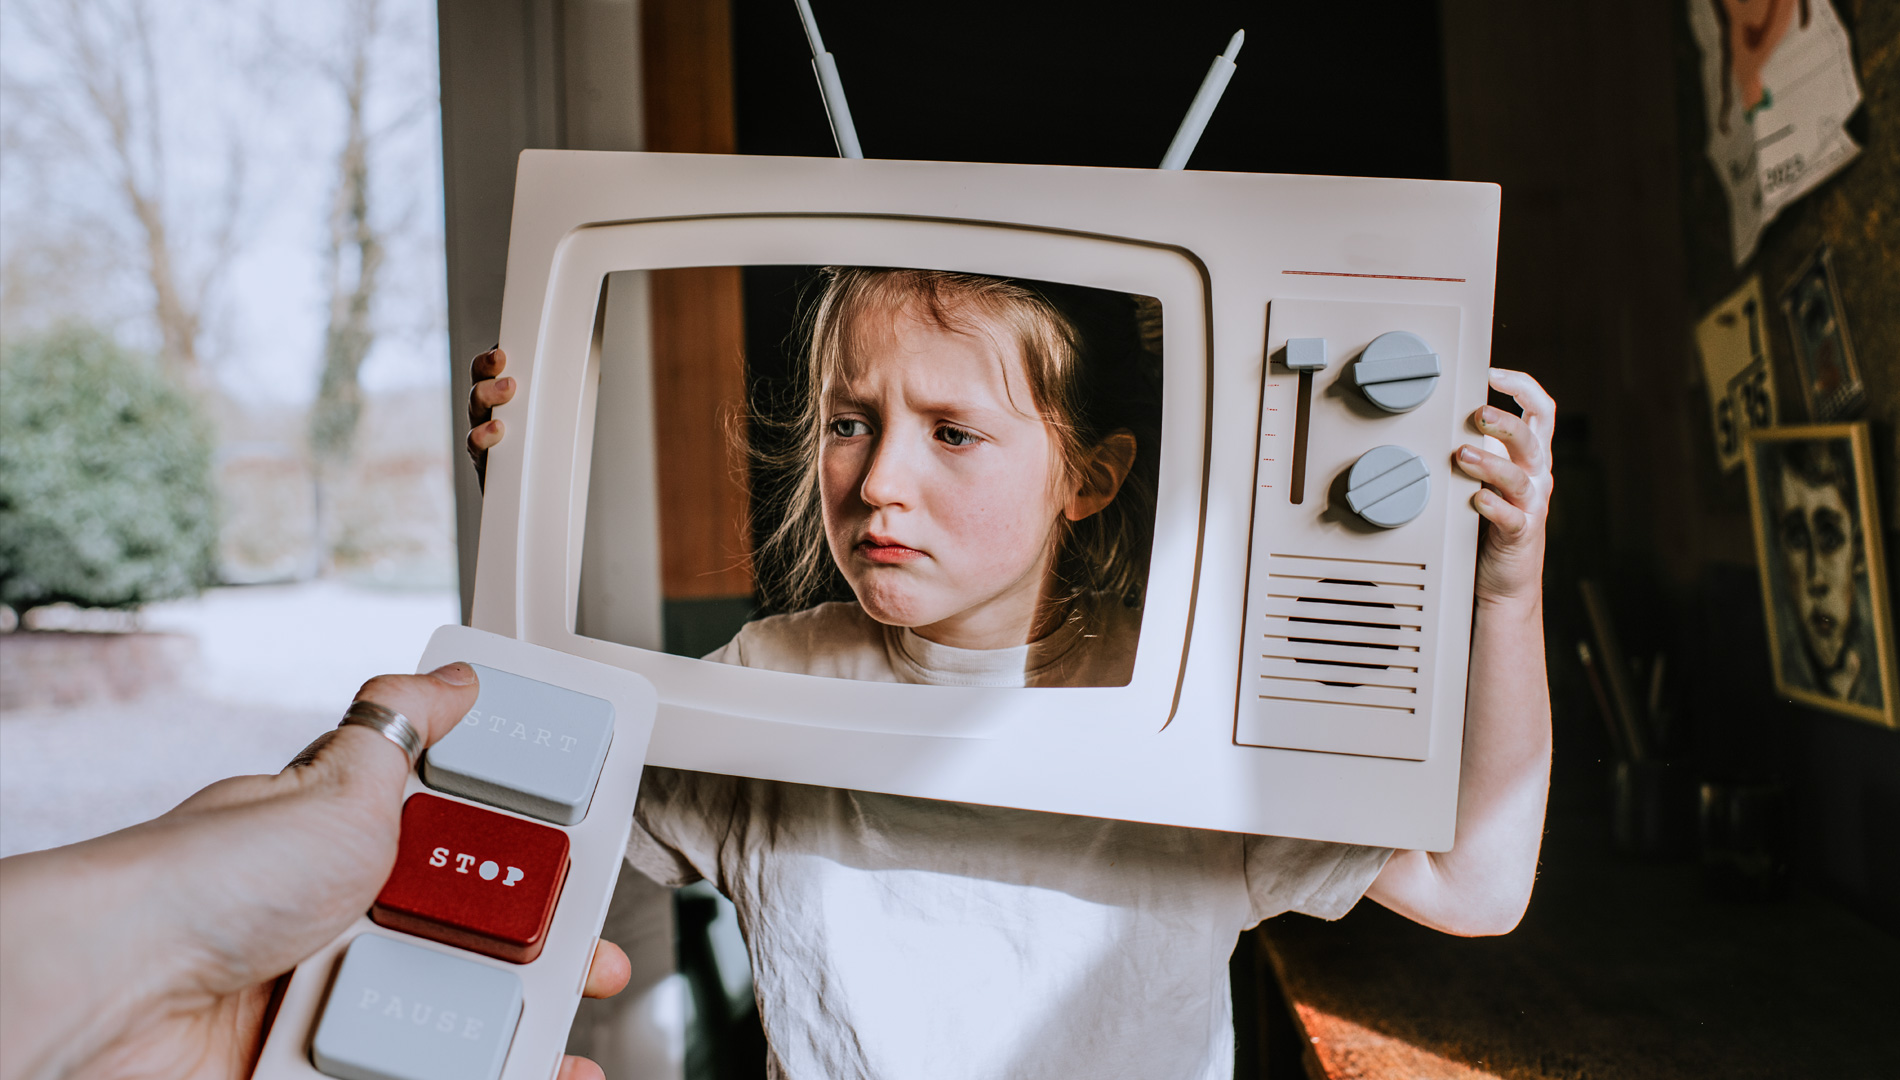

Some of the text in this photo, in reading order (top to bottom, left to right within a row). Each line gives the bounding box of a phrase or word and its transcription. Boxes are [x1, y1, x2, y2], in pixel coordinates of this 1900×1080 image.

[464, 709, 578, 753] START
[429, 846, 524, 887] STOP
[358, 986, 485, 1040] PAUSE
